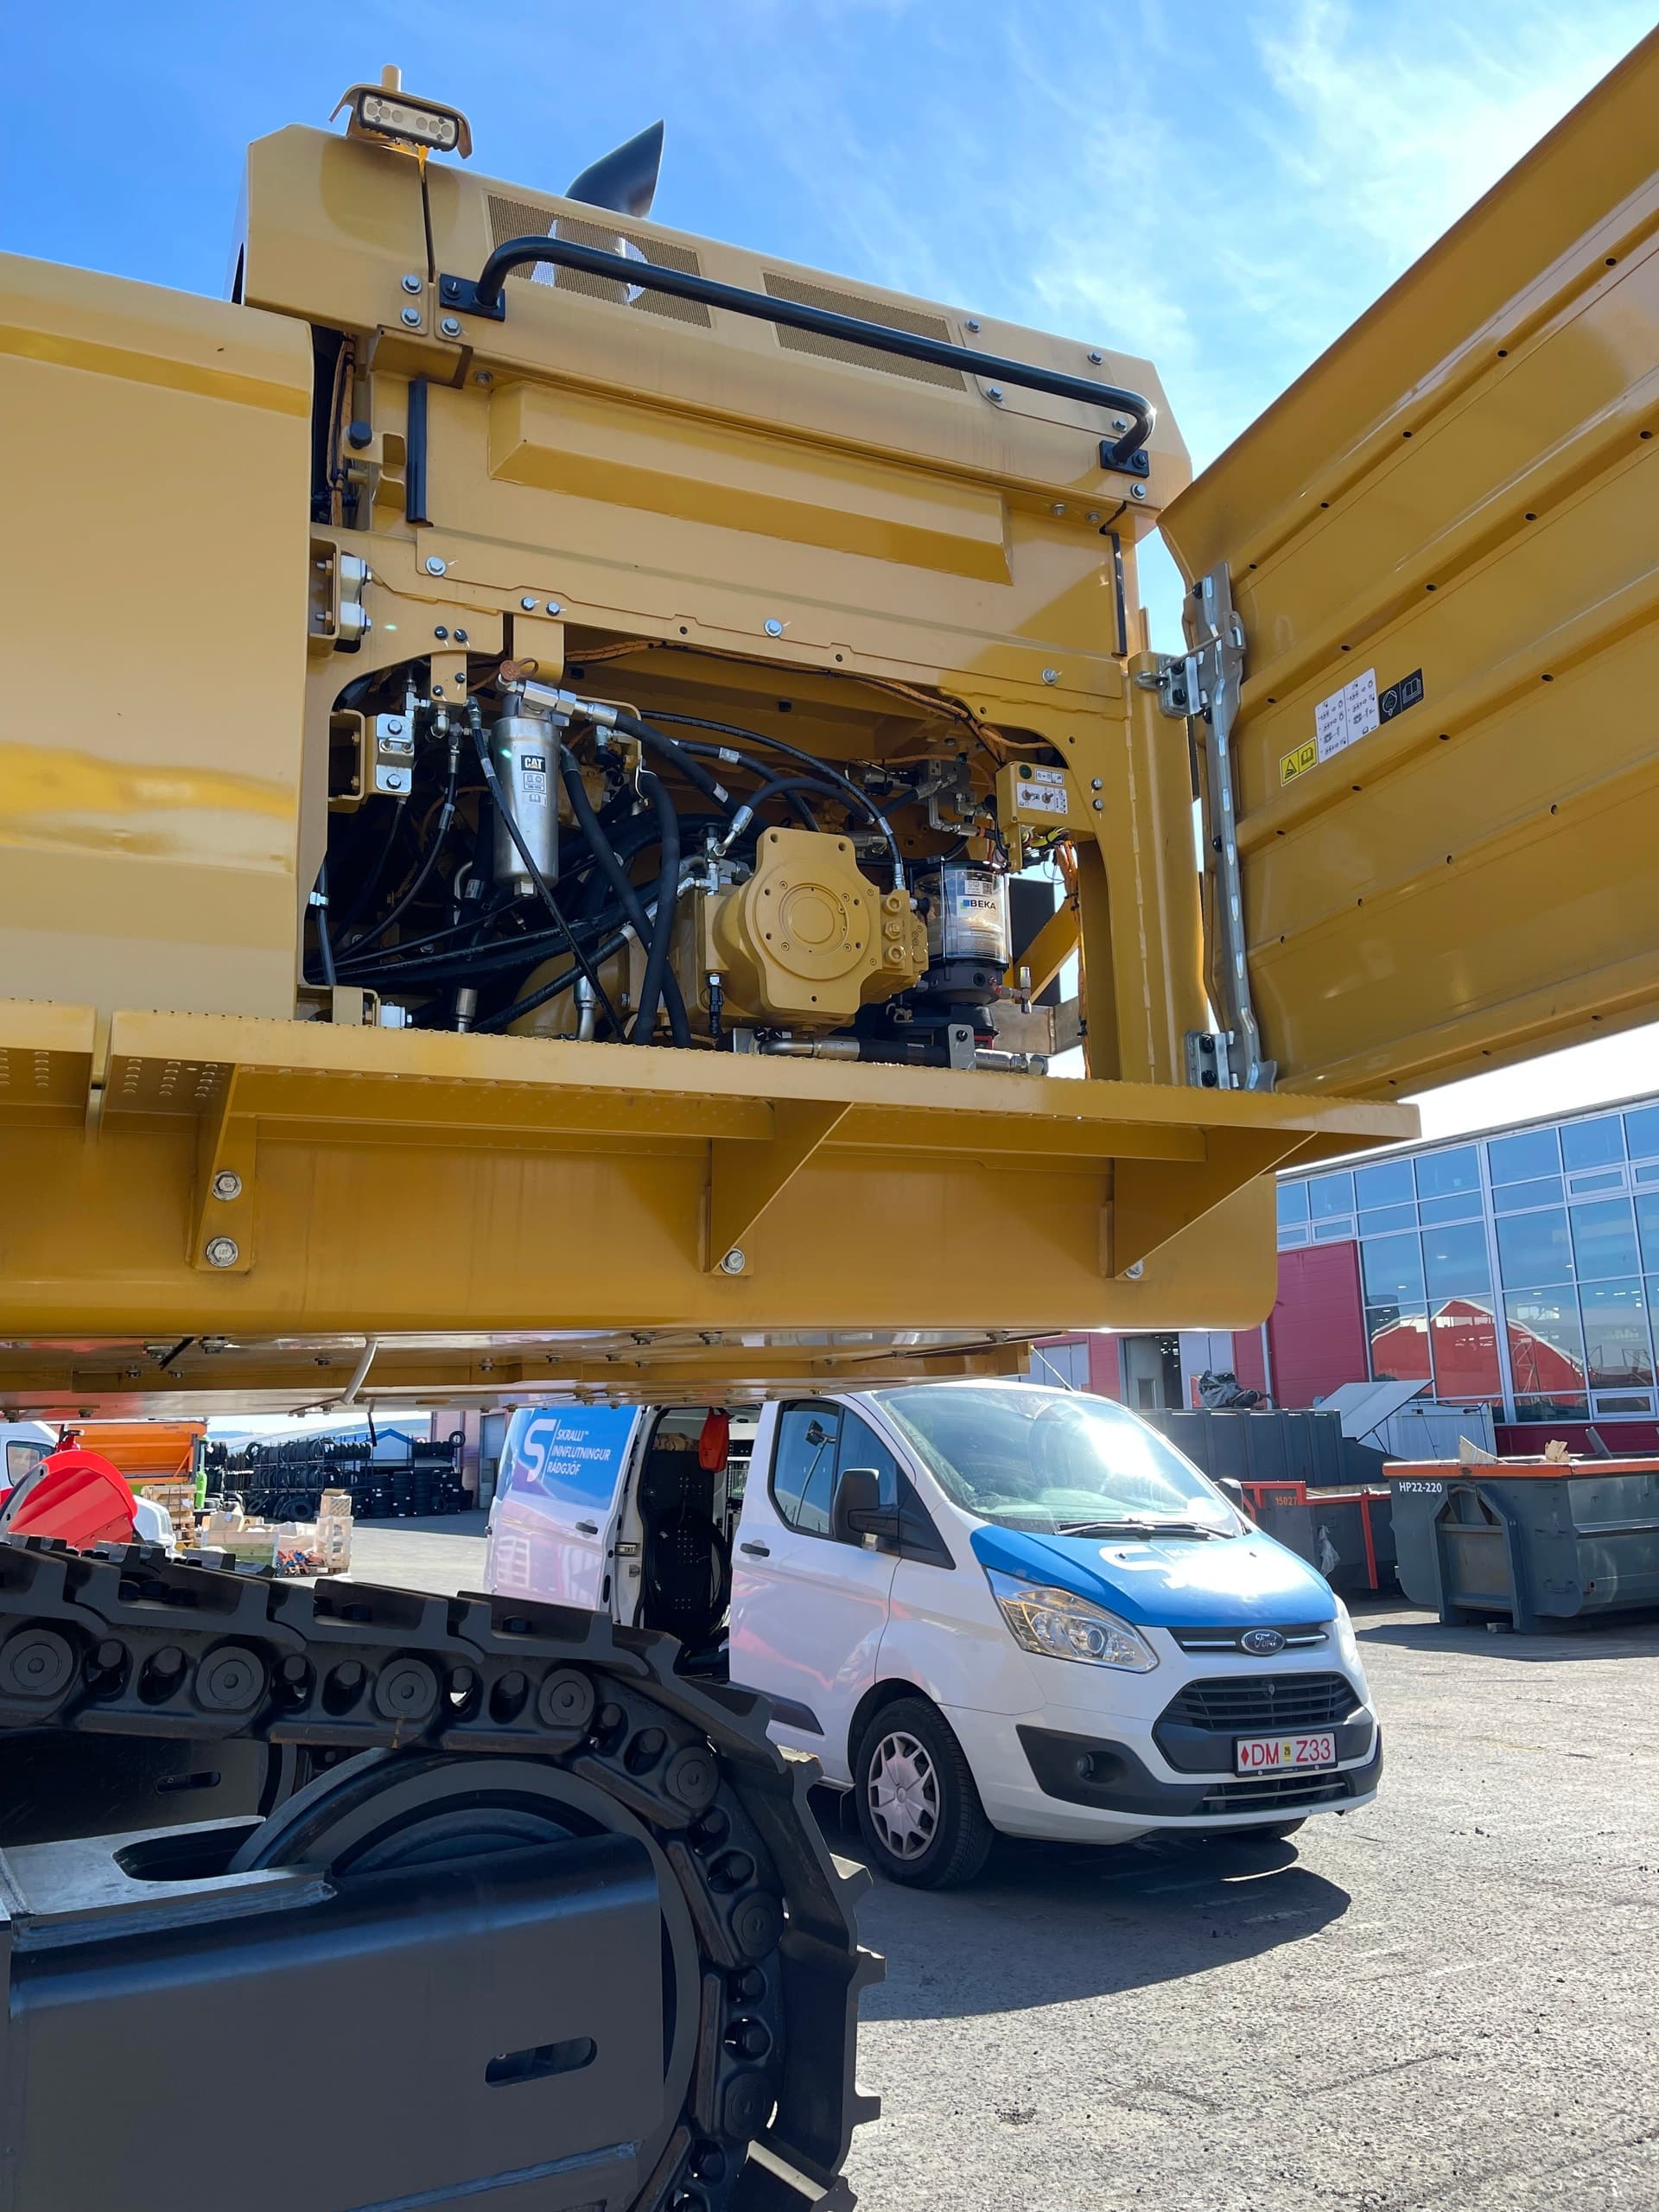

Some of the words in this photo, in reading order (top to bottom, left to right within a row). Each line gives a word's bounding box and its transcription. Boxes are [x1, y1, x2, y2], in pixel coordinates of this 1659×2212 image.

[524, 757, 543, 769] CAT
[970, 899, 996, 910] BEKA
[551, 1445, 612, 1461] INNFLUTNINGUR
[1399, 1482, 1442, 1493] HP22-220
[1254, 1633, 1277, 1649] Ford
[1251, 1742, 1280, 1765] DM
[1296, 1738, 1331, 1762] Z33
